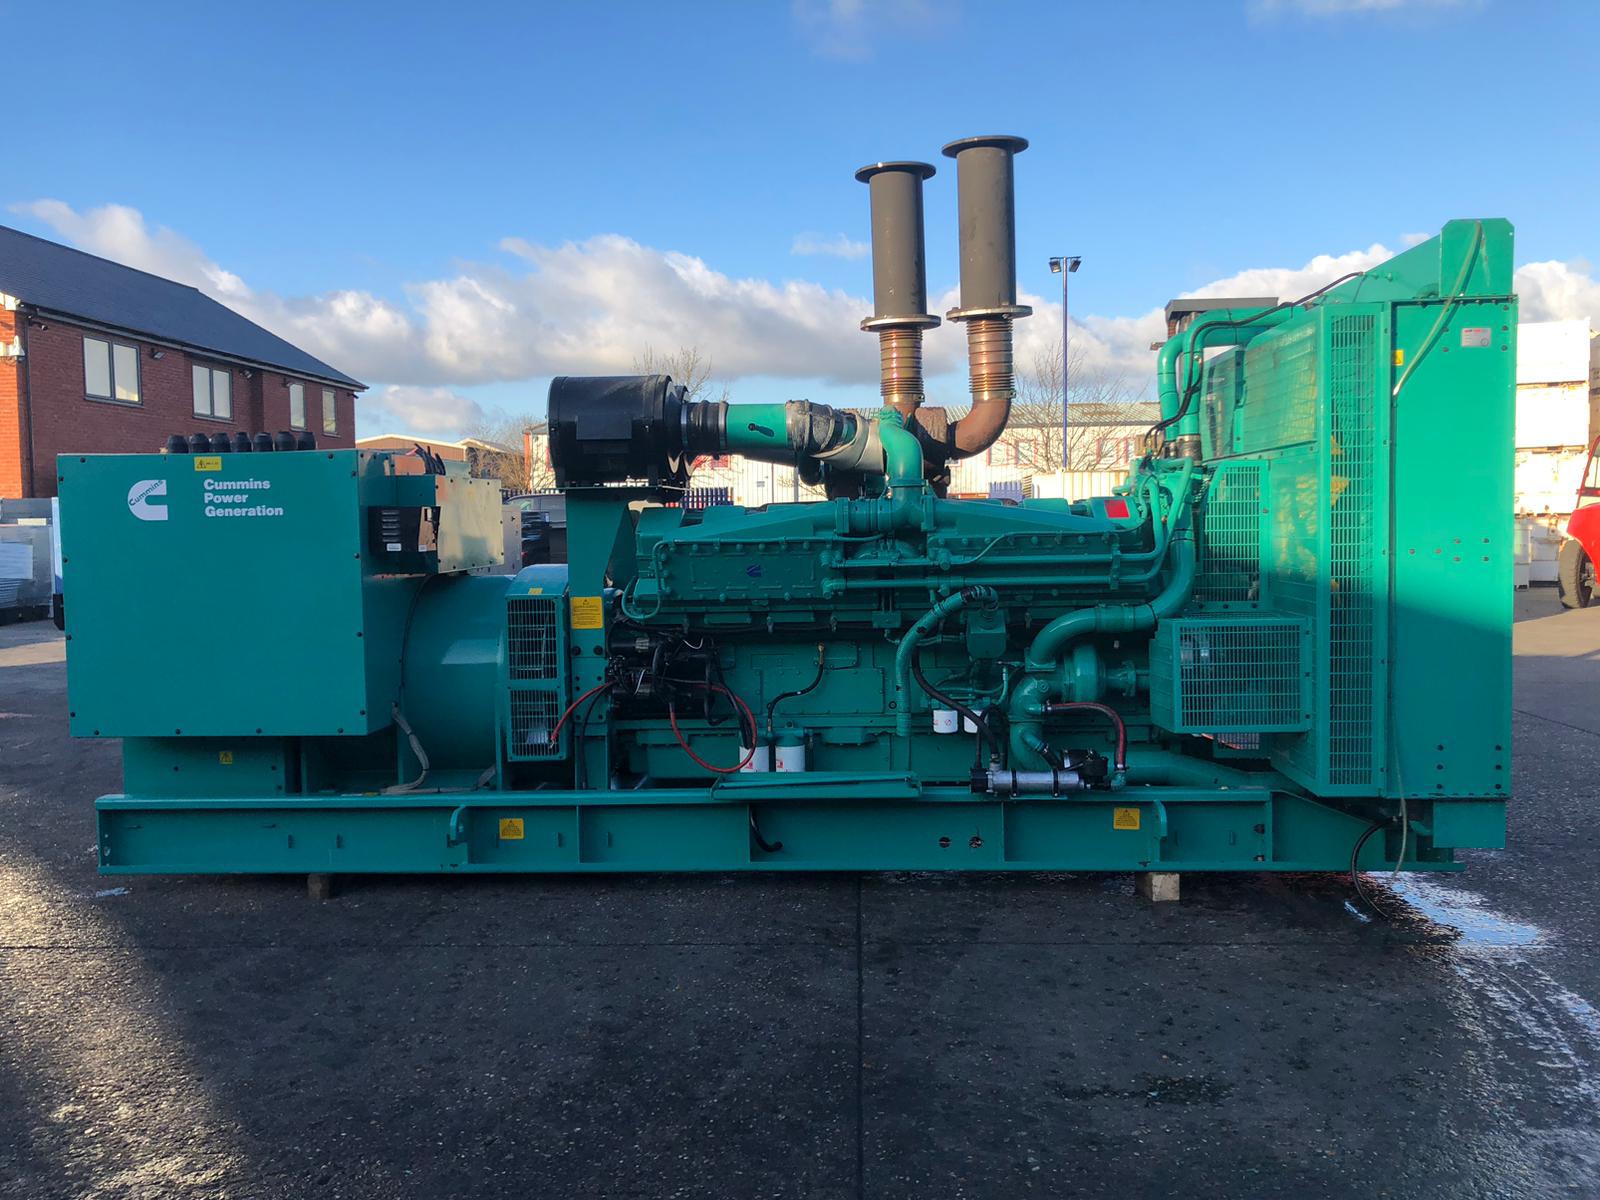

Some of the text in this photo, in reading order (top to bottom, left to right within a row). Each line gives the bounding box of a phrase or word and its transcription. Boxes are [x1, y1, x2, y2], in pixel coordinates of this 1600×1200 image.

[203, 478, 271, 490] Cummins
[129, 479, 164, 507] Cummins
[204, 492, 248, 504] Power
[205, 505, 284, 517] Generation
